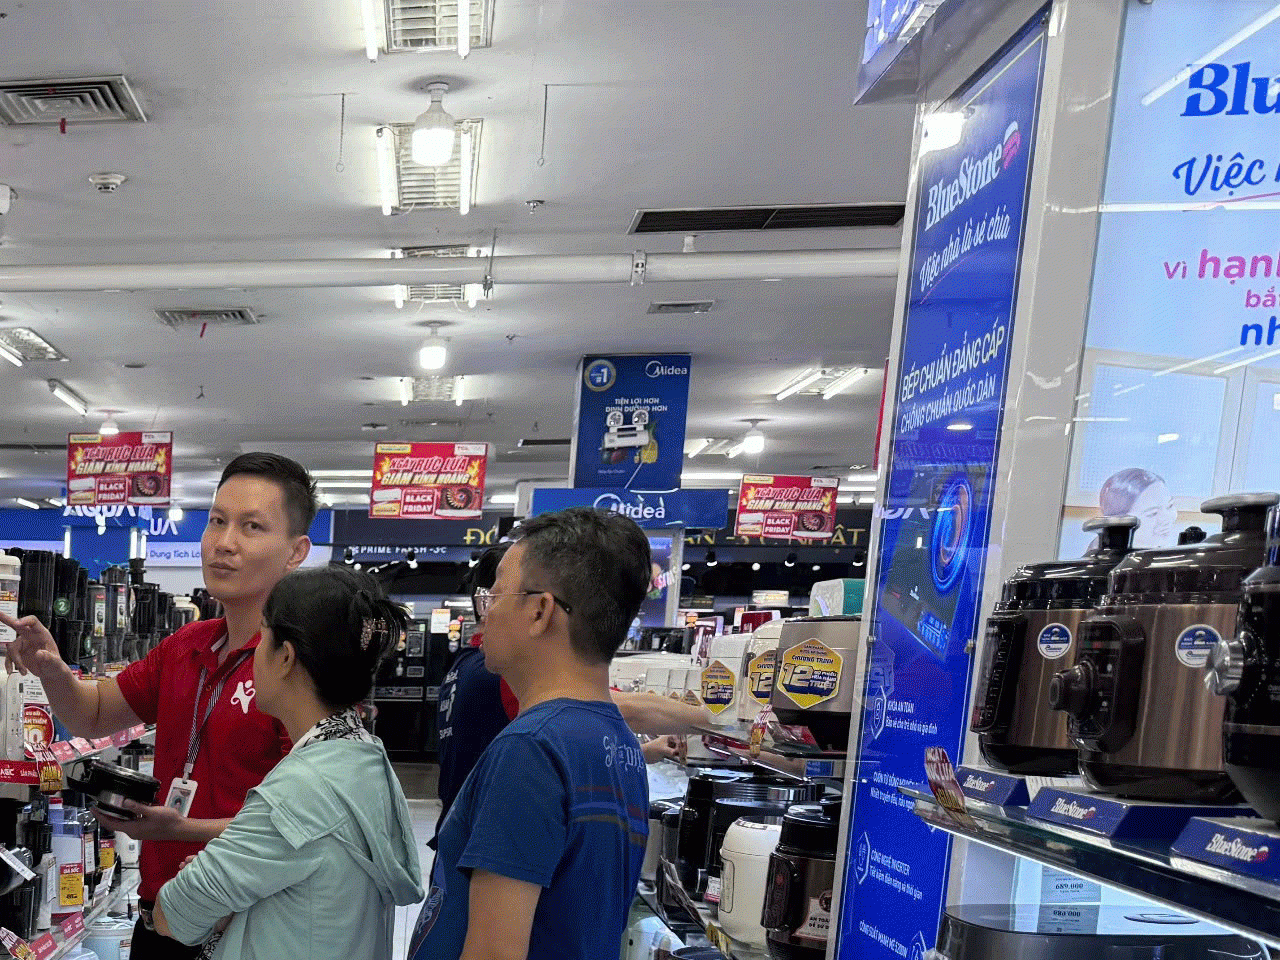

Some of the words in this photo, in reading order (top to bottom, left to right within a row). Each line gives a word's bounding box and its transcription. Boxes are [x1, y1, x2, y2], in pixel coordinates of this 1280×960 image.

[1172, 152, 1266, 196] Việc
[925, 140, 1002, 232] BlueStone
[920, 257, 940, 293] Việc
[941, 235, 961, 269] nhà
[961, 218, 975, 254] là
[987, 211, 1010, 240] chia
[1164, 260, 1189, 279] vì
[645, 361, 687, 378] Midea
[902, 366, 919, 403] BẾP
[920, 343, 952, 392] CHUẨN
[952, 330, 982, 374] ĐẲNG
[981, 317, 1005, 365] CẤP
[953, 382, 978, 417] QUỐC
[977, 373, 996, 406] DÂN
[750, 672, 773, 692] 12
[783, 663, 814, 686] 12
[702, 681, 720, 698] 12
[963, 774, 990, 792] BlueStone
[1051, 797, 1089, 820] BlueStone
[1205, 834, 1257, 862] BlueStone
[1055, 881, 1084, 890] 689.000
